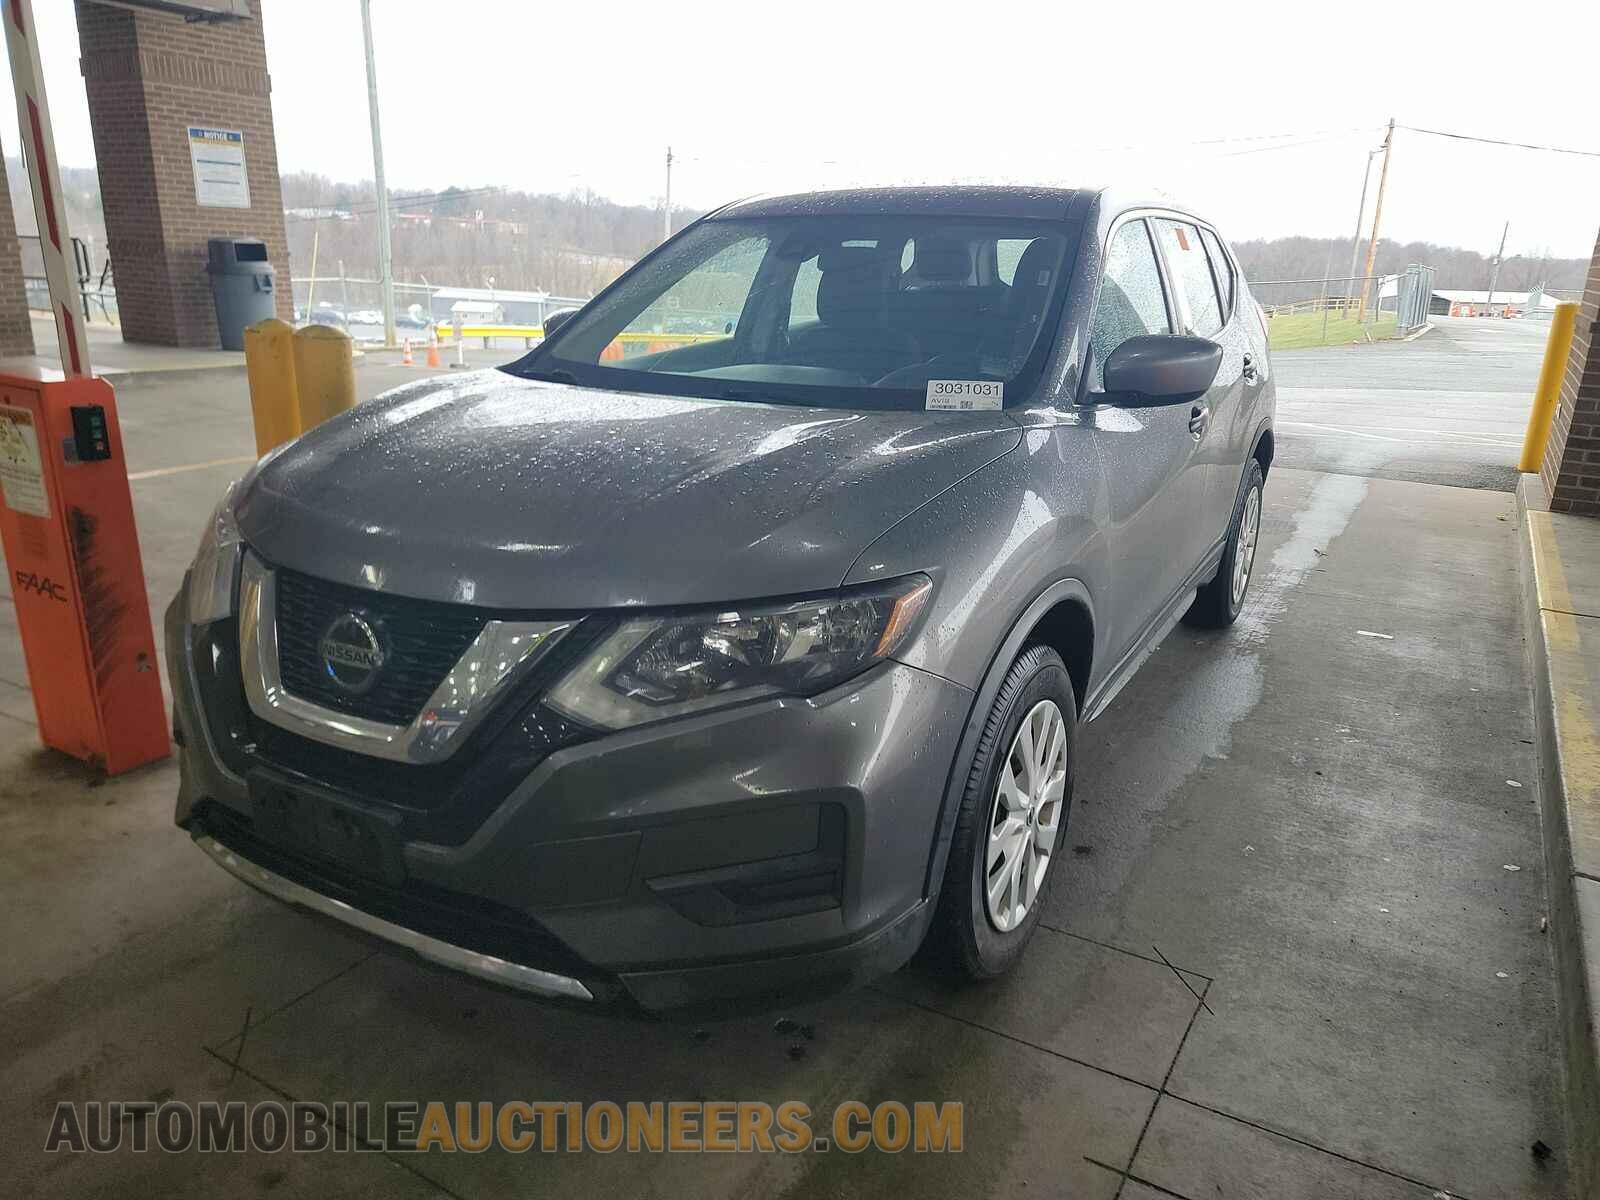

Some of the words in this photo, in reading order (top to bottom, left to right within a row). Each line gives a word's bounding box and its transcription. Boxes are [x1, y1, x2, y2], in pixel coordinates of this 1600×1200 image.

[935, 383, 1000, 396] 3031031
[16, 571, 68, 603] FAAC
[322, 642, 374, 665] NISSAN
